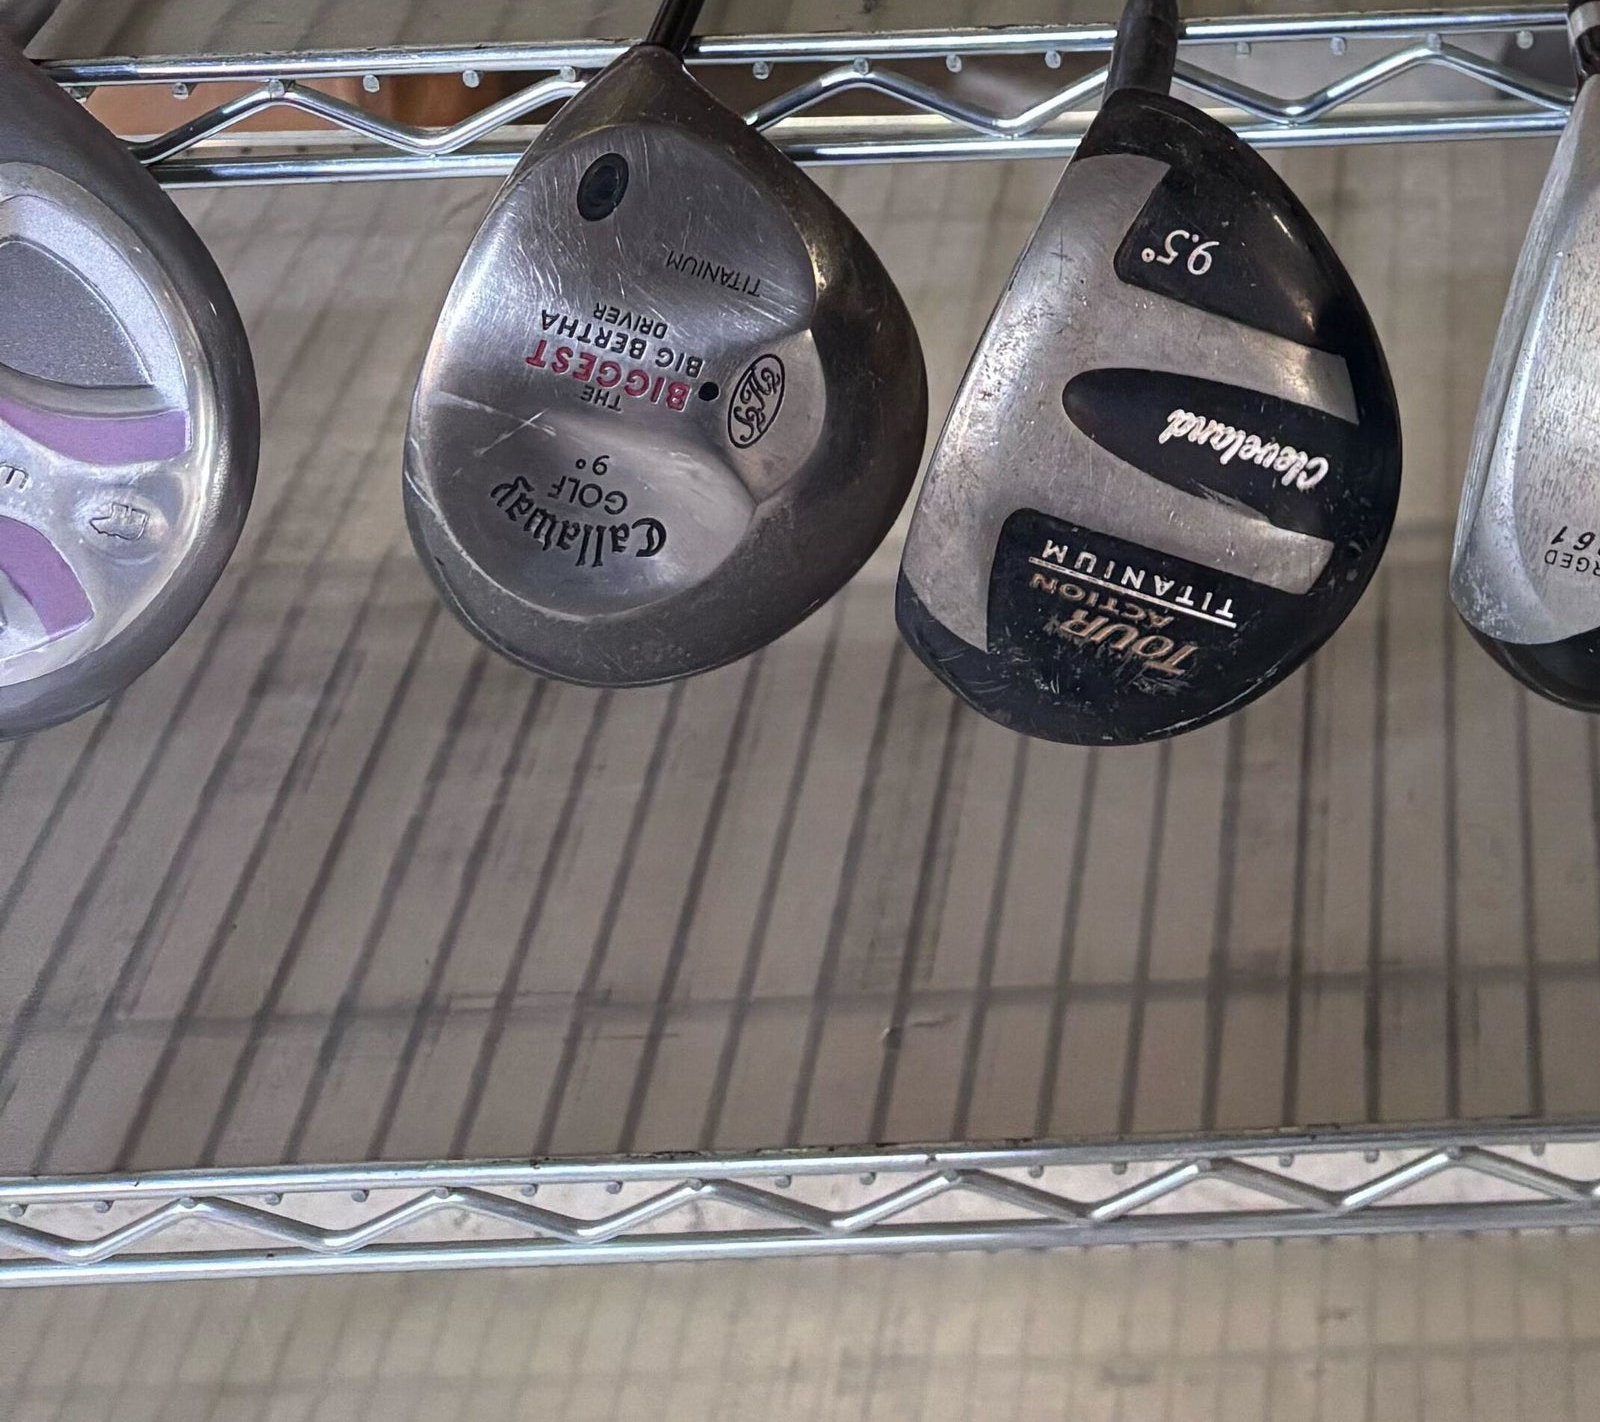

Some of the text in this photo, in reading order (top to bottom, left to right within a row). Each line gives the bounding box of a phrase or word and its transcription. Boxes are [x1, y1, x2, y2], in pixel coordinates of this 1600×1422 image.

[666, 250, 761, 298] TITANIUM
[1141, 229, 1221, 275] 9.5°
[540, 309, 706, 379] BIG BERTHA
[593, 303, 668, 340] DRIVER
[526, 339, 692, 412] BIGGEST
[579, 384, 623, 413] THE
[575, 455, 610, 476] 9°
[1159, 408, 1330, 491] Cleveland
[490, 475, 667, 569] Callaway
[548, 475, 629, 515] GOLF
[1030, 572, 1175, 629] ACTION
[1042, 539, 1235, 620] TITANIUM
[1058, 609, 1200, 677] TOUR
